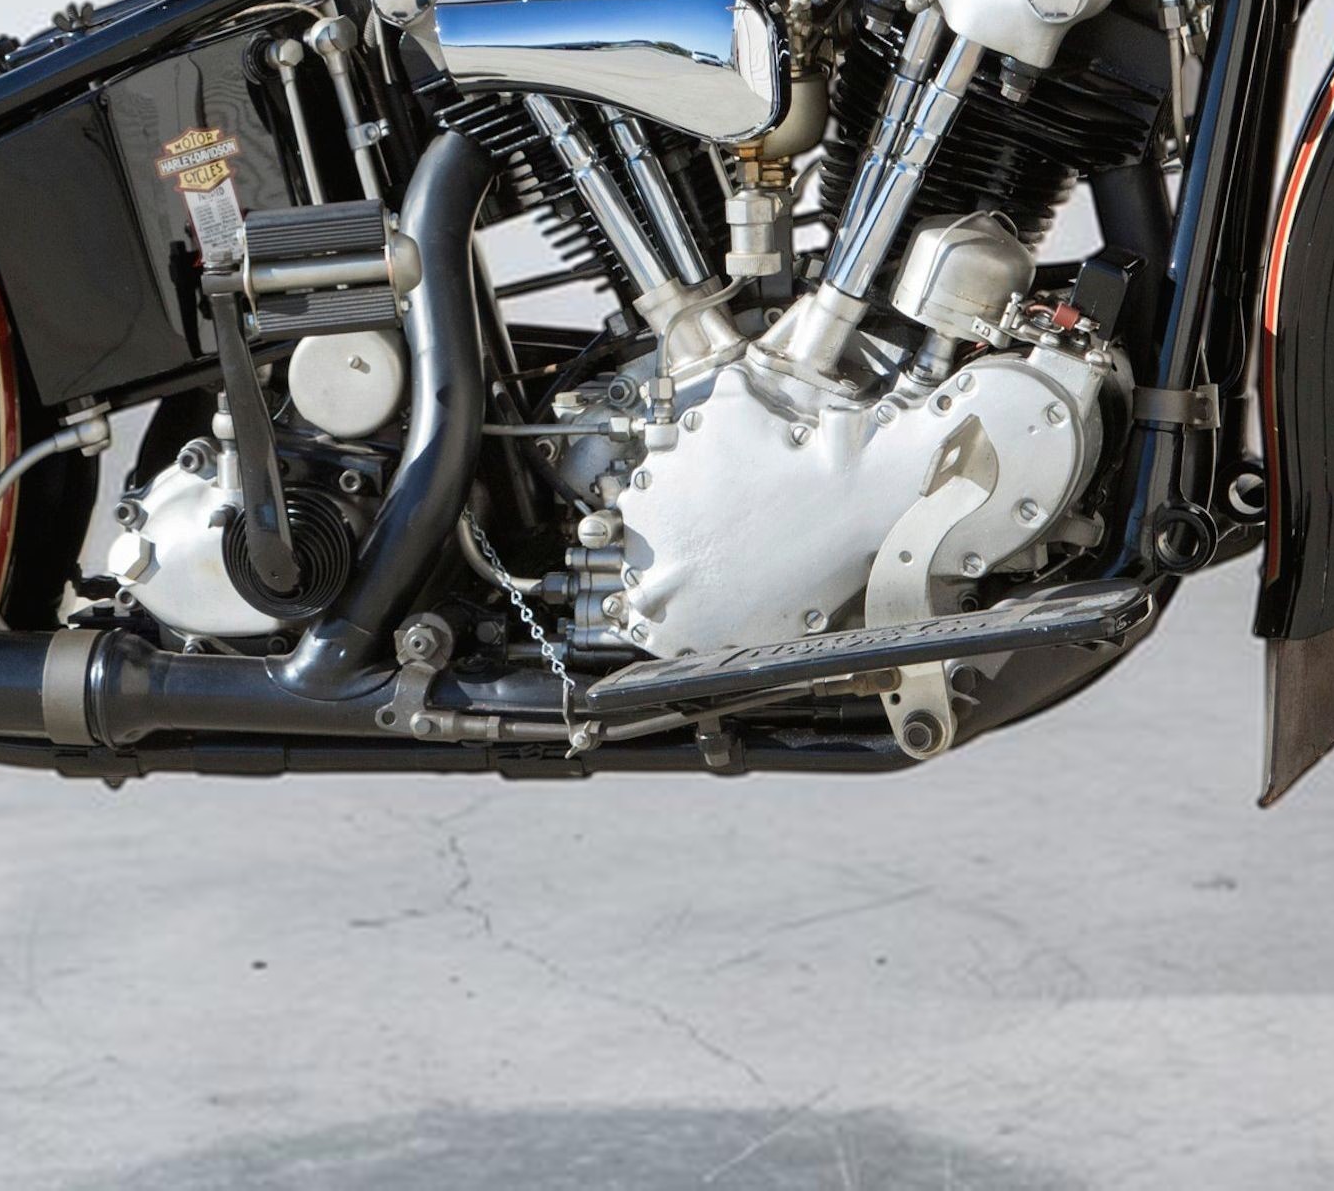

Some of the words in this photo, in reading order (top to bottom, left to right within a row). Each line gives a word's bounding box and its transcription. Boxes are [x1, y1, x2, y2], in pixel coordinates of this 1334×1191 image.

[174, 132, 213, 151] MOTOR
[161, 141, 236, 174] HARLEY-DAVIDSON
[183, 163, 223, 185] CYCLES
